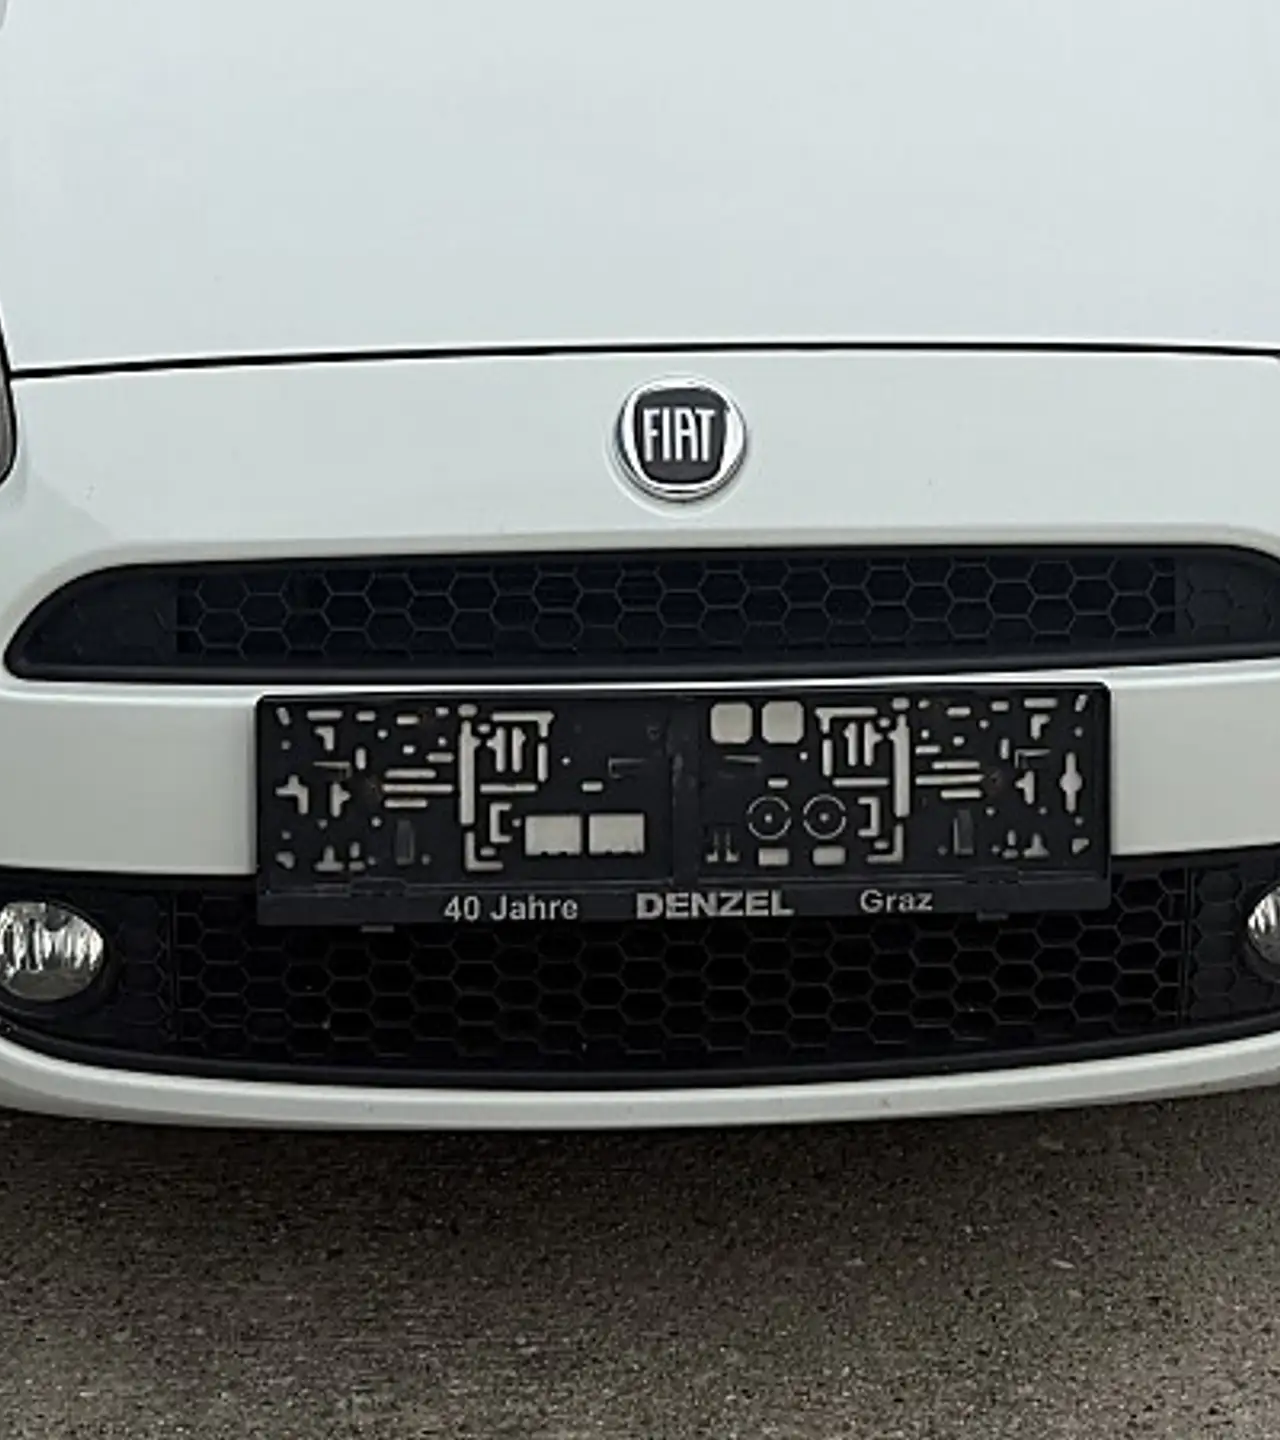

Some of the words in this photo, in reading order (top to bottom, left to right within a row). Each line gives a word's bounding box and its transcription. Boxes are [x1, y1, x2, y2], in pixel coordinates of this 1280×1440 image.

[642, 407, 716, 462] FIAT
[444, 894, 481, 922] 40
[490, 894, 578, 921] Jahre
[635, 890, 795, 920] DENZEL
[859, 888, 934, 913] Graz
